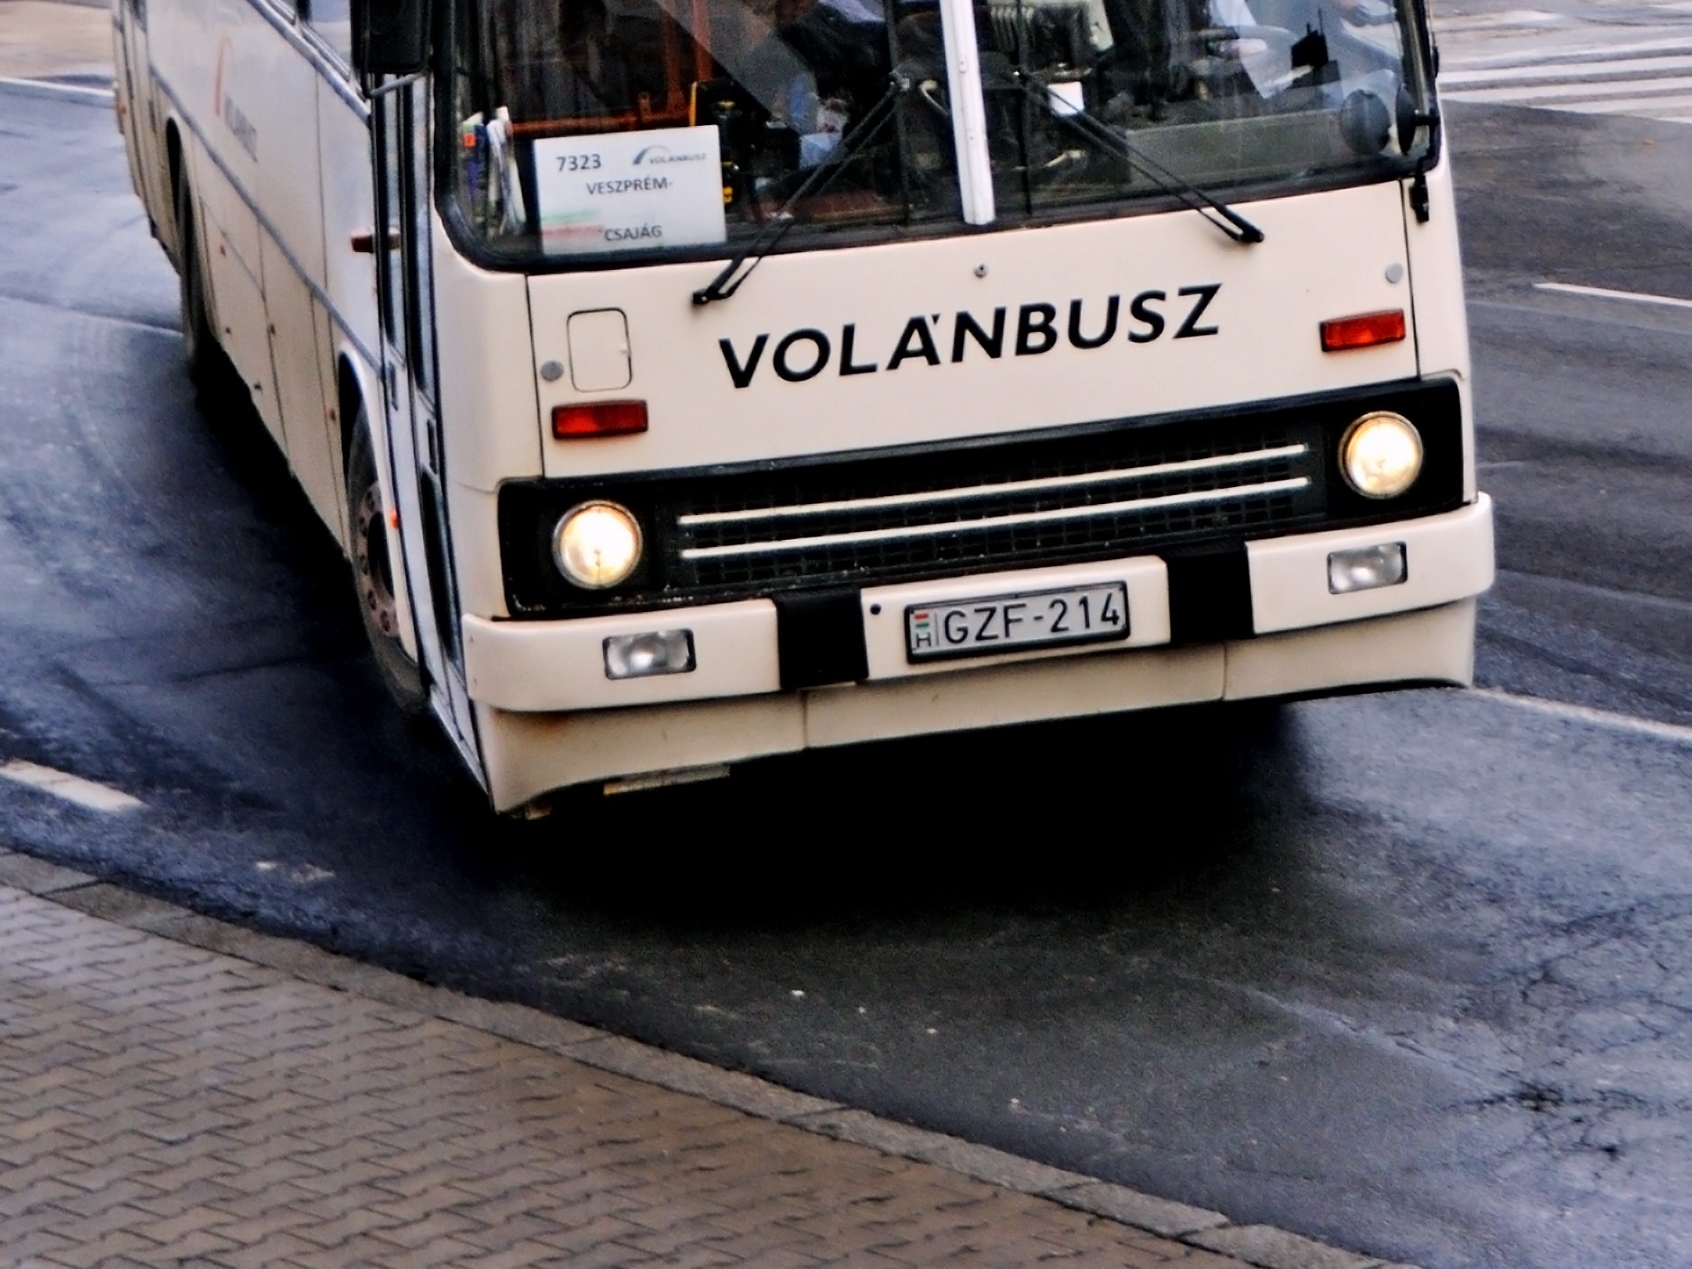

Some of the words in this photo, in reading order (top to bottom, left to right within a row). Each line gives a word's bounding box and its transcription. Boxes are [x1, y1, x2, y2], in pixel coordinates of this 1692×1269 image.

[556, 153, 602, 173] 7323
[604, 223, 663, 242] CSAJÁG
[719, 283, 1223, 389] VOLÁNBUSZ
[915, 632, 933, 650] H
[943, 592, 1121, 645] GZF-214
